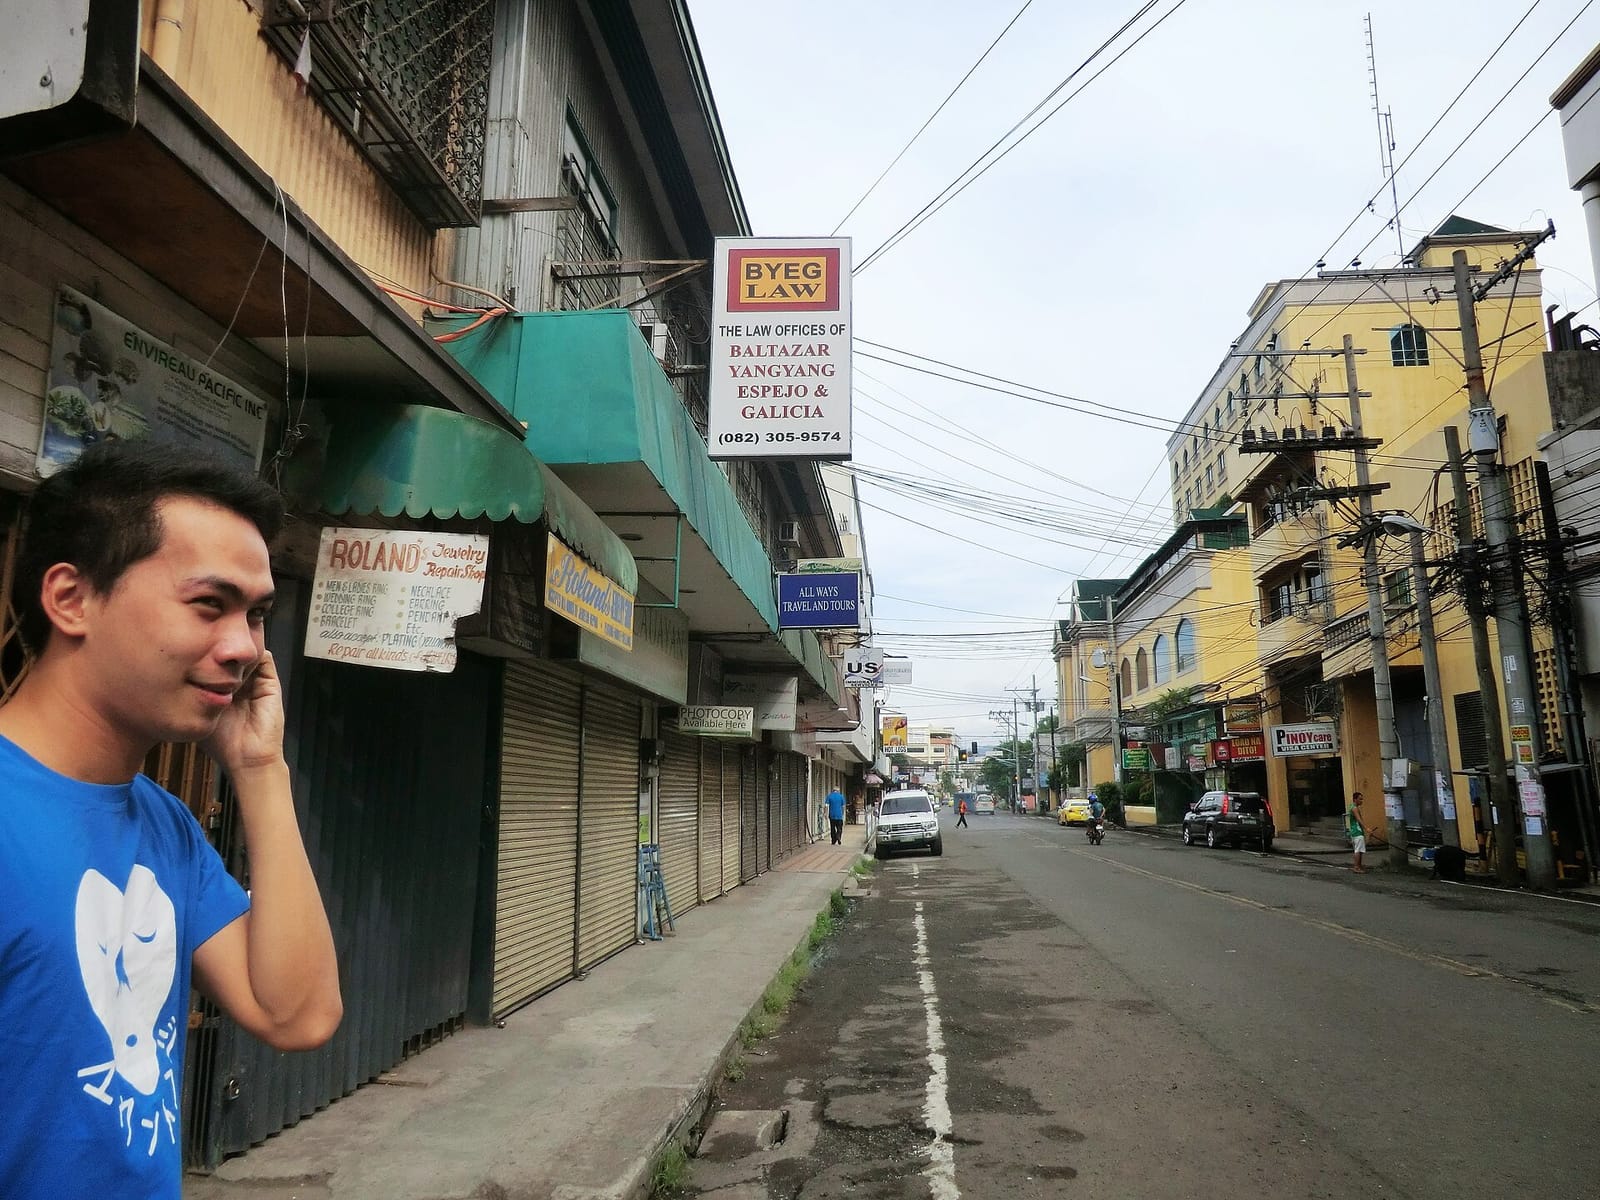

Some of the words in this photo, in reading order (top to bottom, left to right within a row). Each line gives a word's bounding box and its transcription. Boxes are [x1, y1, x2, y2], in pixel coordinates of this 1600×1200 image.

[745, 262, 822, 280] BYEG
[745, 283, 822, 299] LAW
[719, 325, 742, 337] THE
[746, 325, 772, 337] LAW
[775, 324, 826, 337] OFFICES
[829, 323, 846, 336] OF
[729, 343, 831, 358] BALTAZAR
[123, 331, 196, 382] ENVIREAU
[198, 369, 243, 410] PACIFIC
[728, 363, 836, 378] YANGYANG
[737, 384, 809, 399] ESPEJO
[814, 384, 829, 398] &
[741, 405, 825, 420] GALICIA
[718, 432, 760, 445] (082)
[765, 431, 841, 443] 305-9574
[432, 542, 486, 564] Jewelry
[799, 586, 815, 598] ALL
[816, 586, 839, 597] WAYS
[783, 601, 812, 612] TRAVEL
[812, 600, 829, 611] AND
[830, 599, 856, 611] TOURS
[680, 707, 752, 721] PHOTOCOPY
[683, 718, 724, 729] Available
[725, 719, 747, 730] Here
